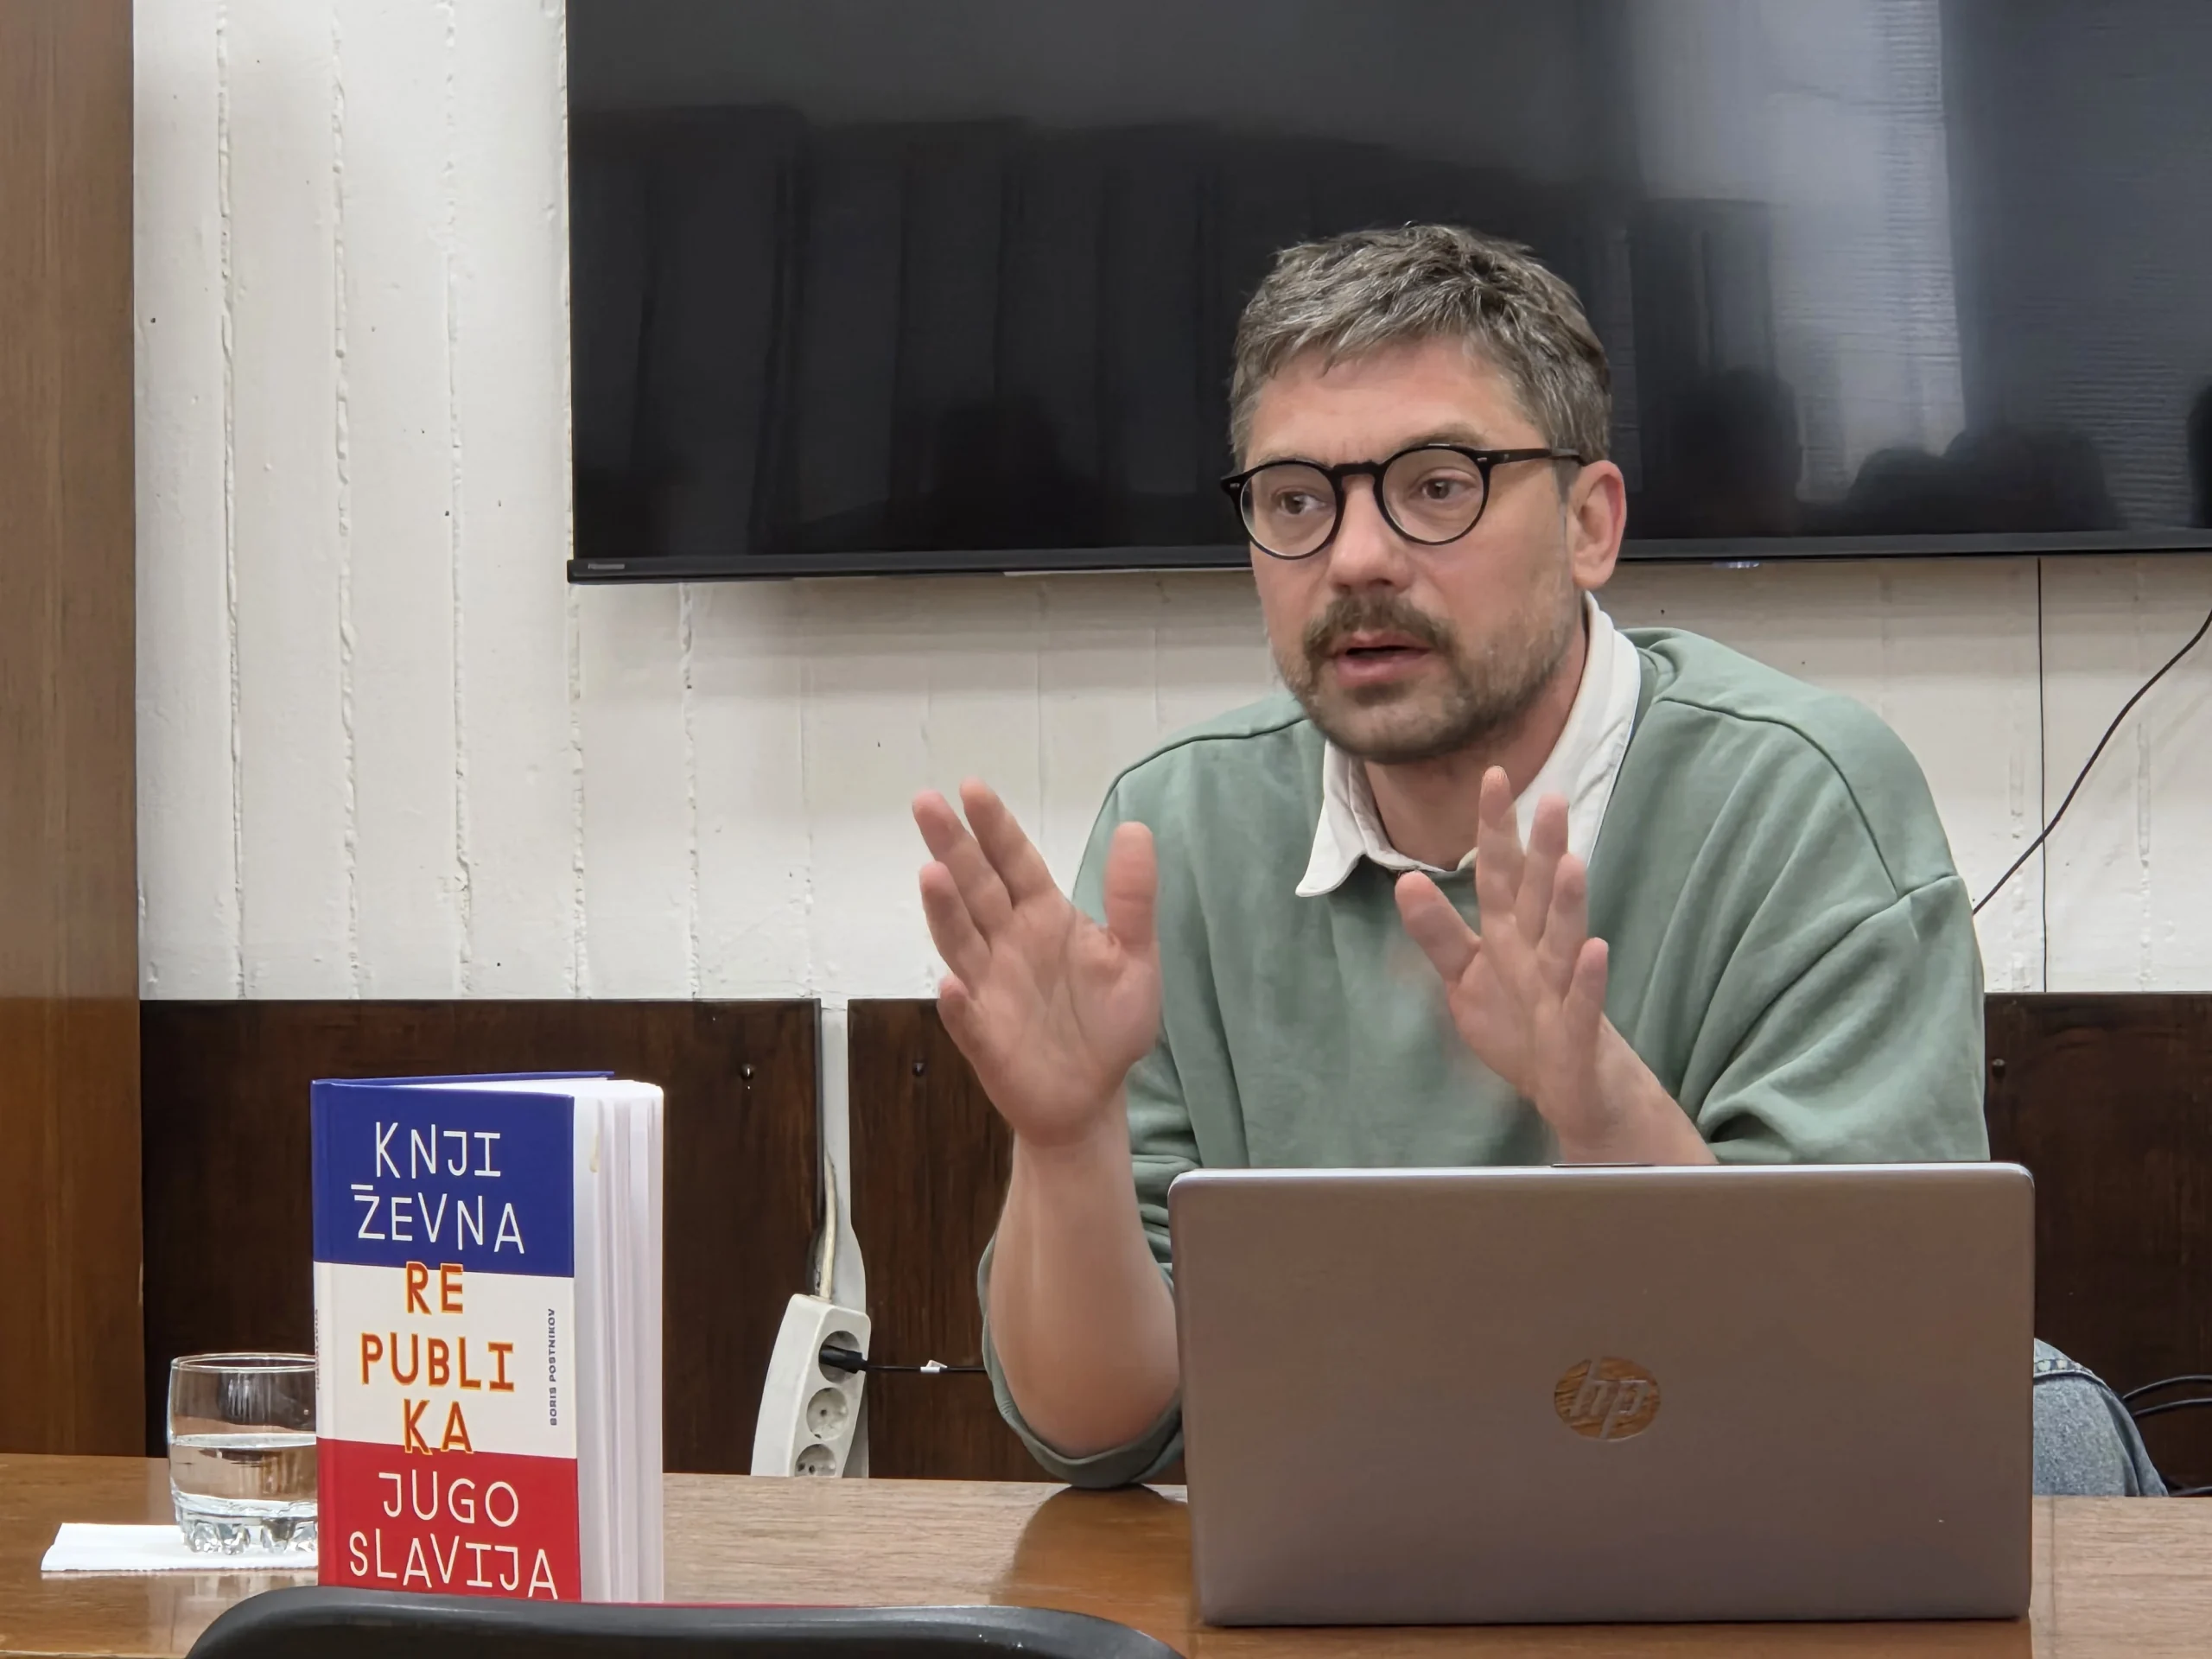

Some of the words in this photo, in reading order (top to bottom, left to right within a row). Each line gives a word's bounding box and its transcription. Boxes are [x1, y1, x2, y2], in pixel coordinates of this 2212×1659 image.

[376, 1122, 501, 1178] KNJI
[404, 1261, 464, 1314] RE
[360, 1332, 515, 1392] PUBLI
[548, 1308, 556, 1382] POSTNIKOV
[403, 1398, 474, 1455] KA
[1570, 1357, 1649, 1438] hp
[378, 1469, 518, 1527] JUGO
[348, 1529, 558, 1599] SLAVIJA
